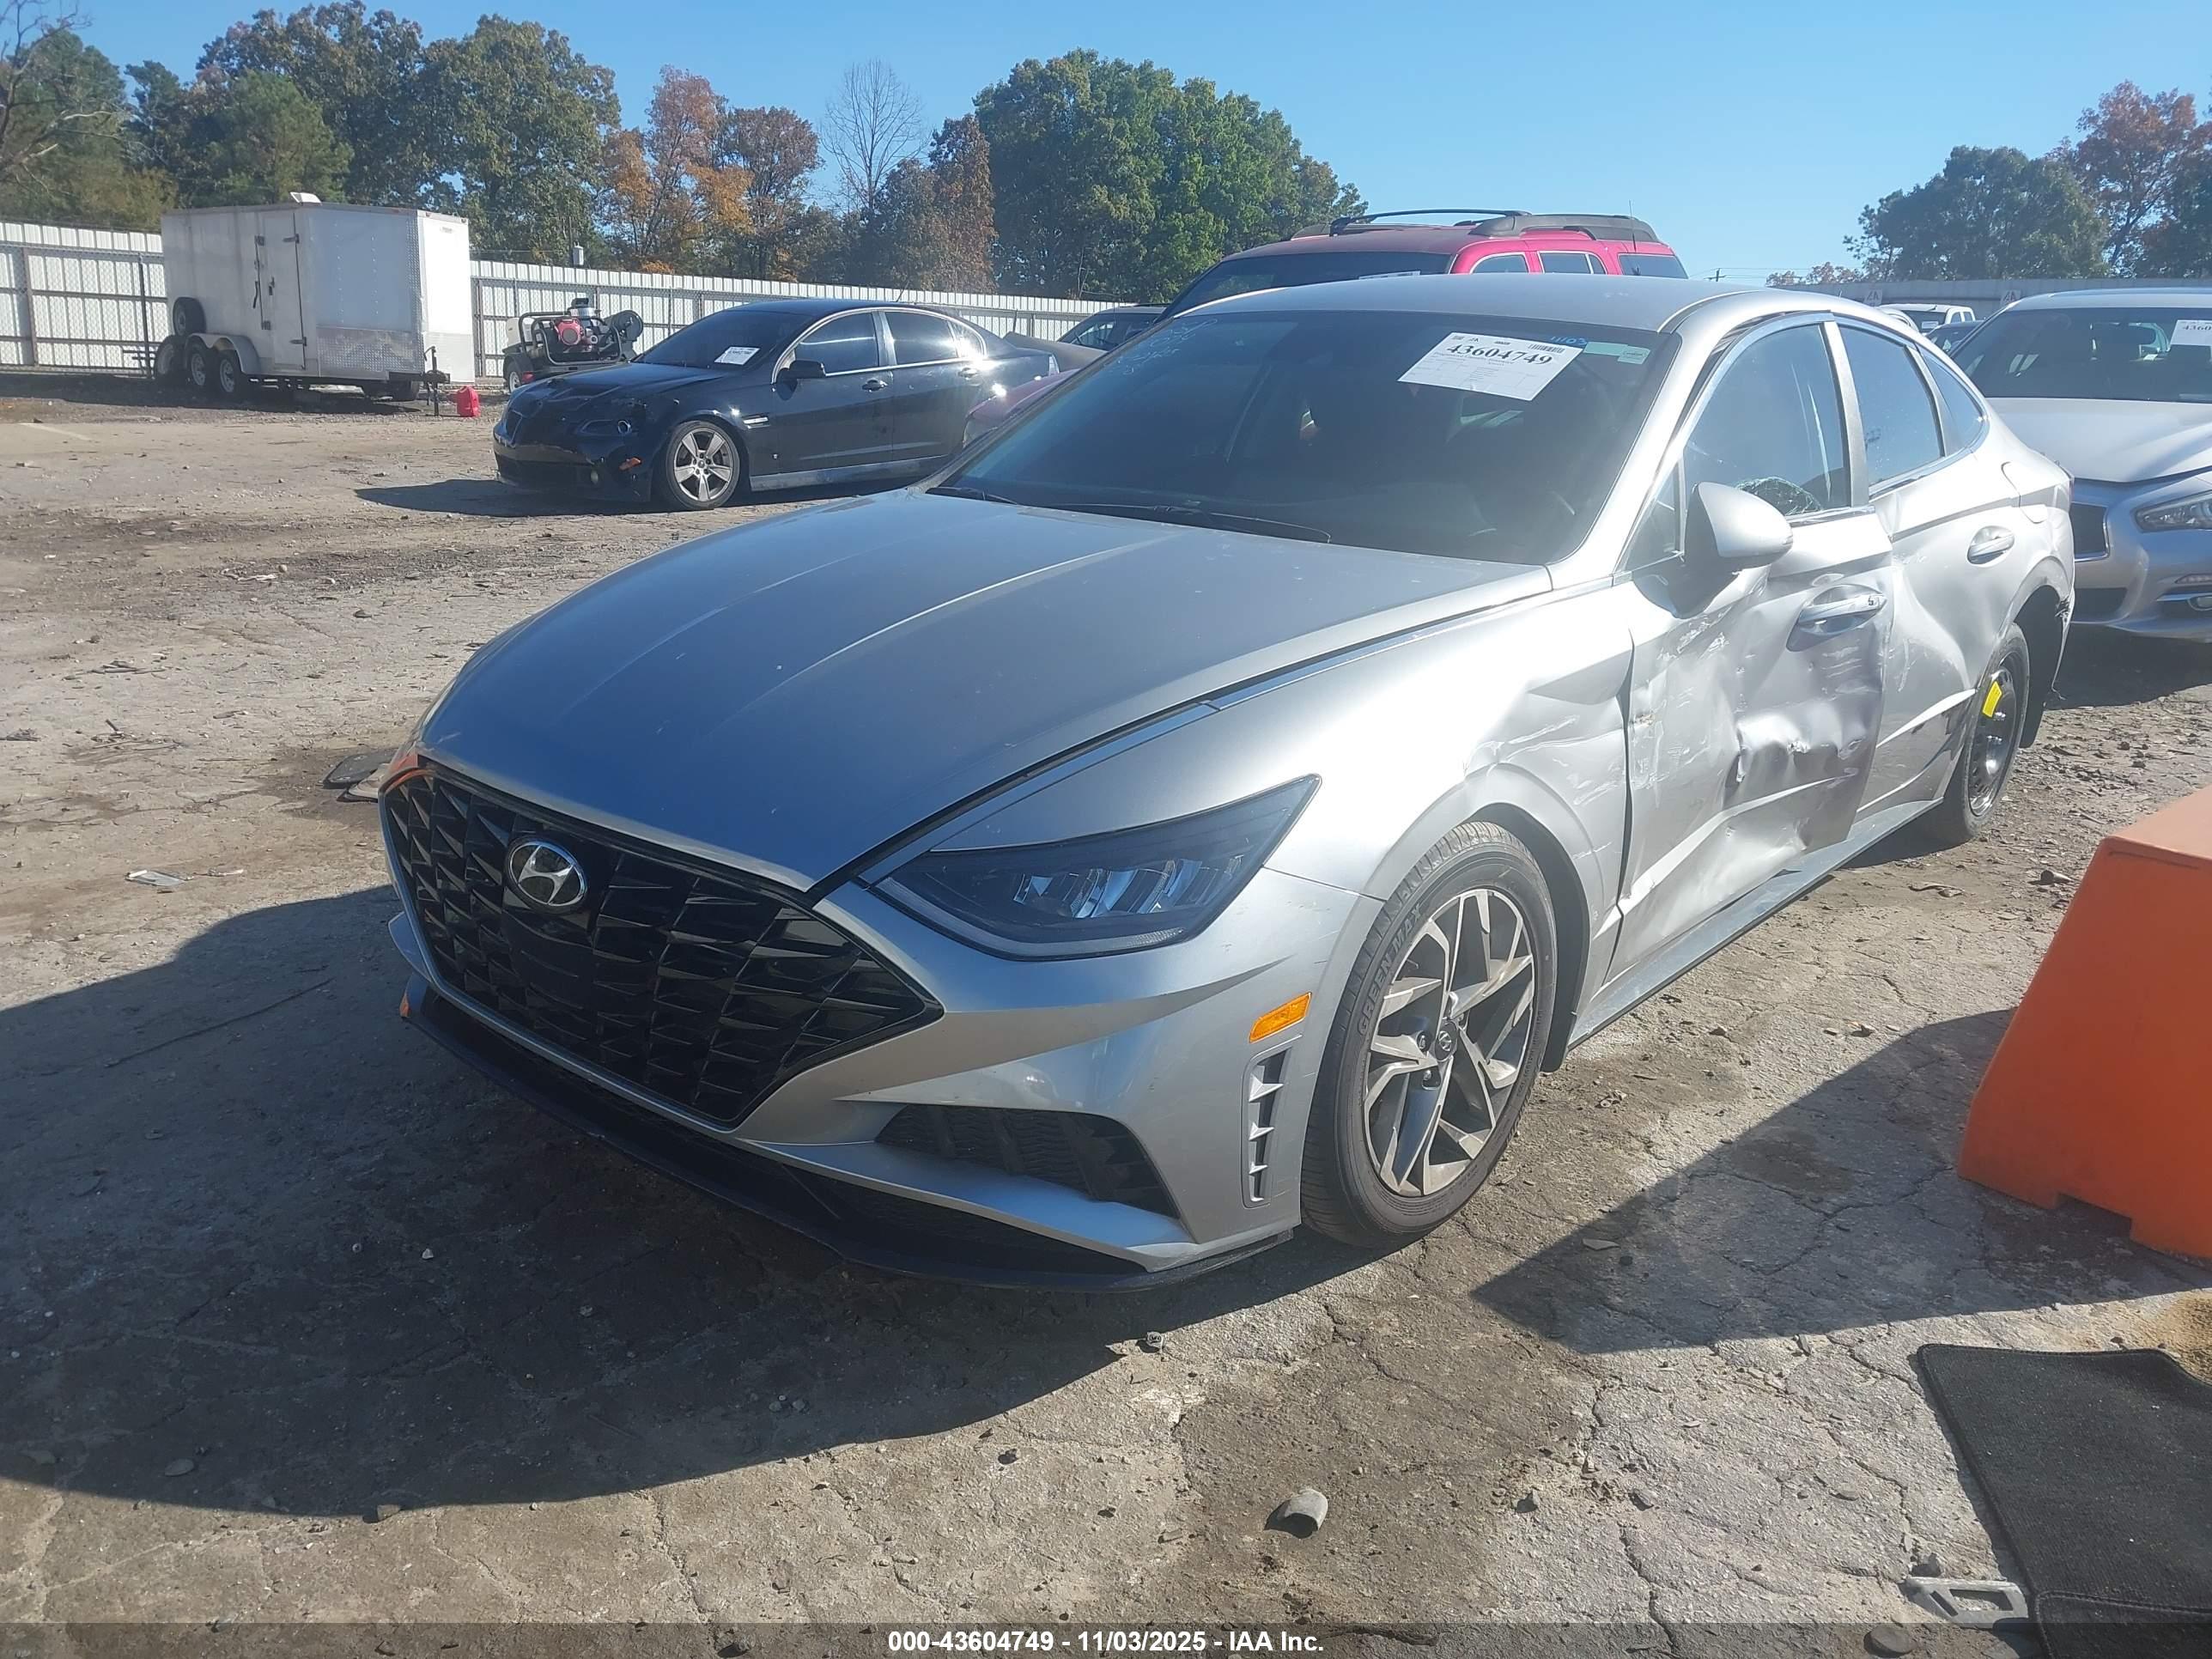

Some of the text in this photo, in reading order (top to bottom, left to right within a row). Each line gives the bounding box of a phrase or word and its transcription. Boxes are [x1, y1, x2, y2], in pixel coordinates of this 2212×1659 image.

[1446, 343, 1553, 365] 43604749
[1358, 902, 1422, 1036] GREEN MAX
